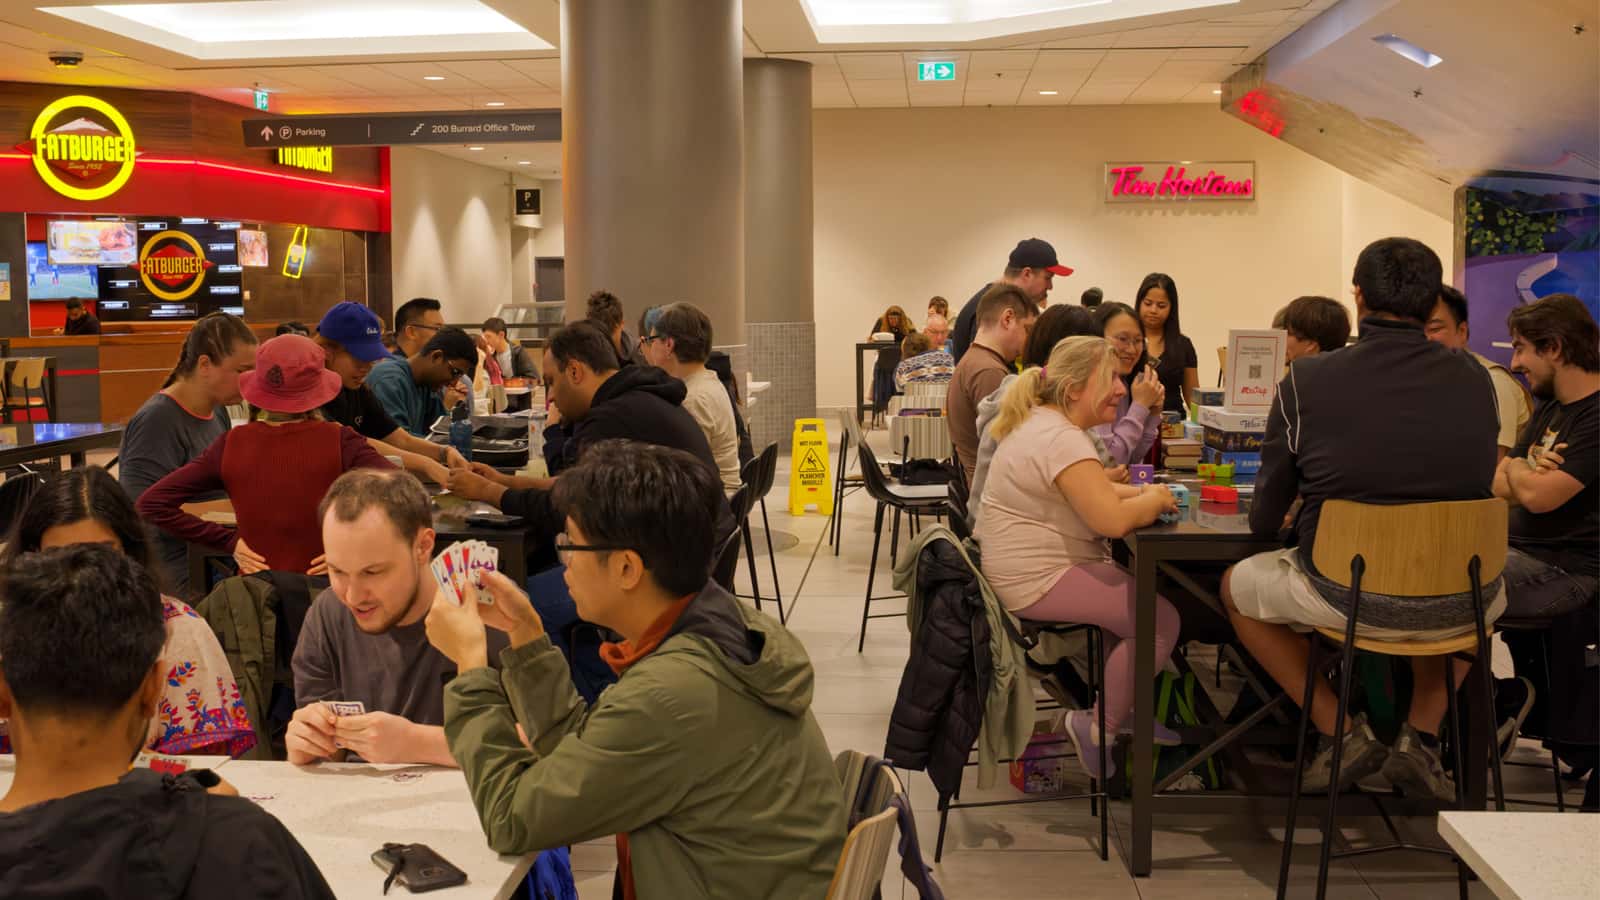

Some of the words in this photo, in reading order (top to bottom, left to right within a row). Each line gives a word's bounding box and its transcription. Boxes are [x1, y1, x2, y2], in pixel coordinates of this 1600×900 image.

[295, 127, 327, 137] Parking
[431, 124, 449, 134] 200
[450, 124, 482, 133] Burrard
[483, 123, 509, 132] Office
[510, 123, 536, 132] Tower
[35, 133, 135, 162] FATBURGER
[1110, 166, 1157, 197] Tim
[1158, 166, 1252, 197] Hortons
[524, 191, 532, 202] P
[141, 256, 203, 275] FATBURGER
